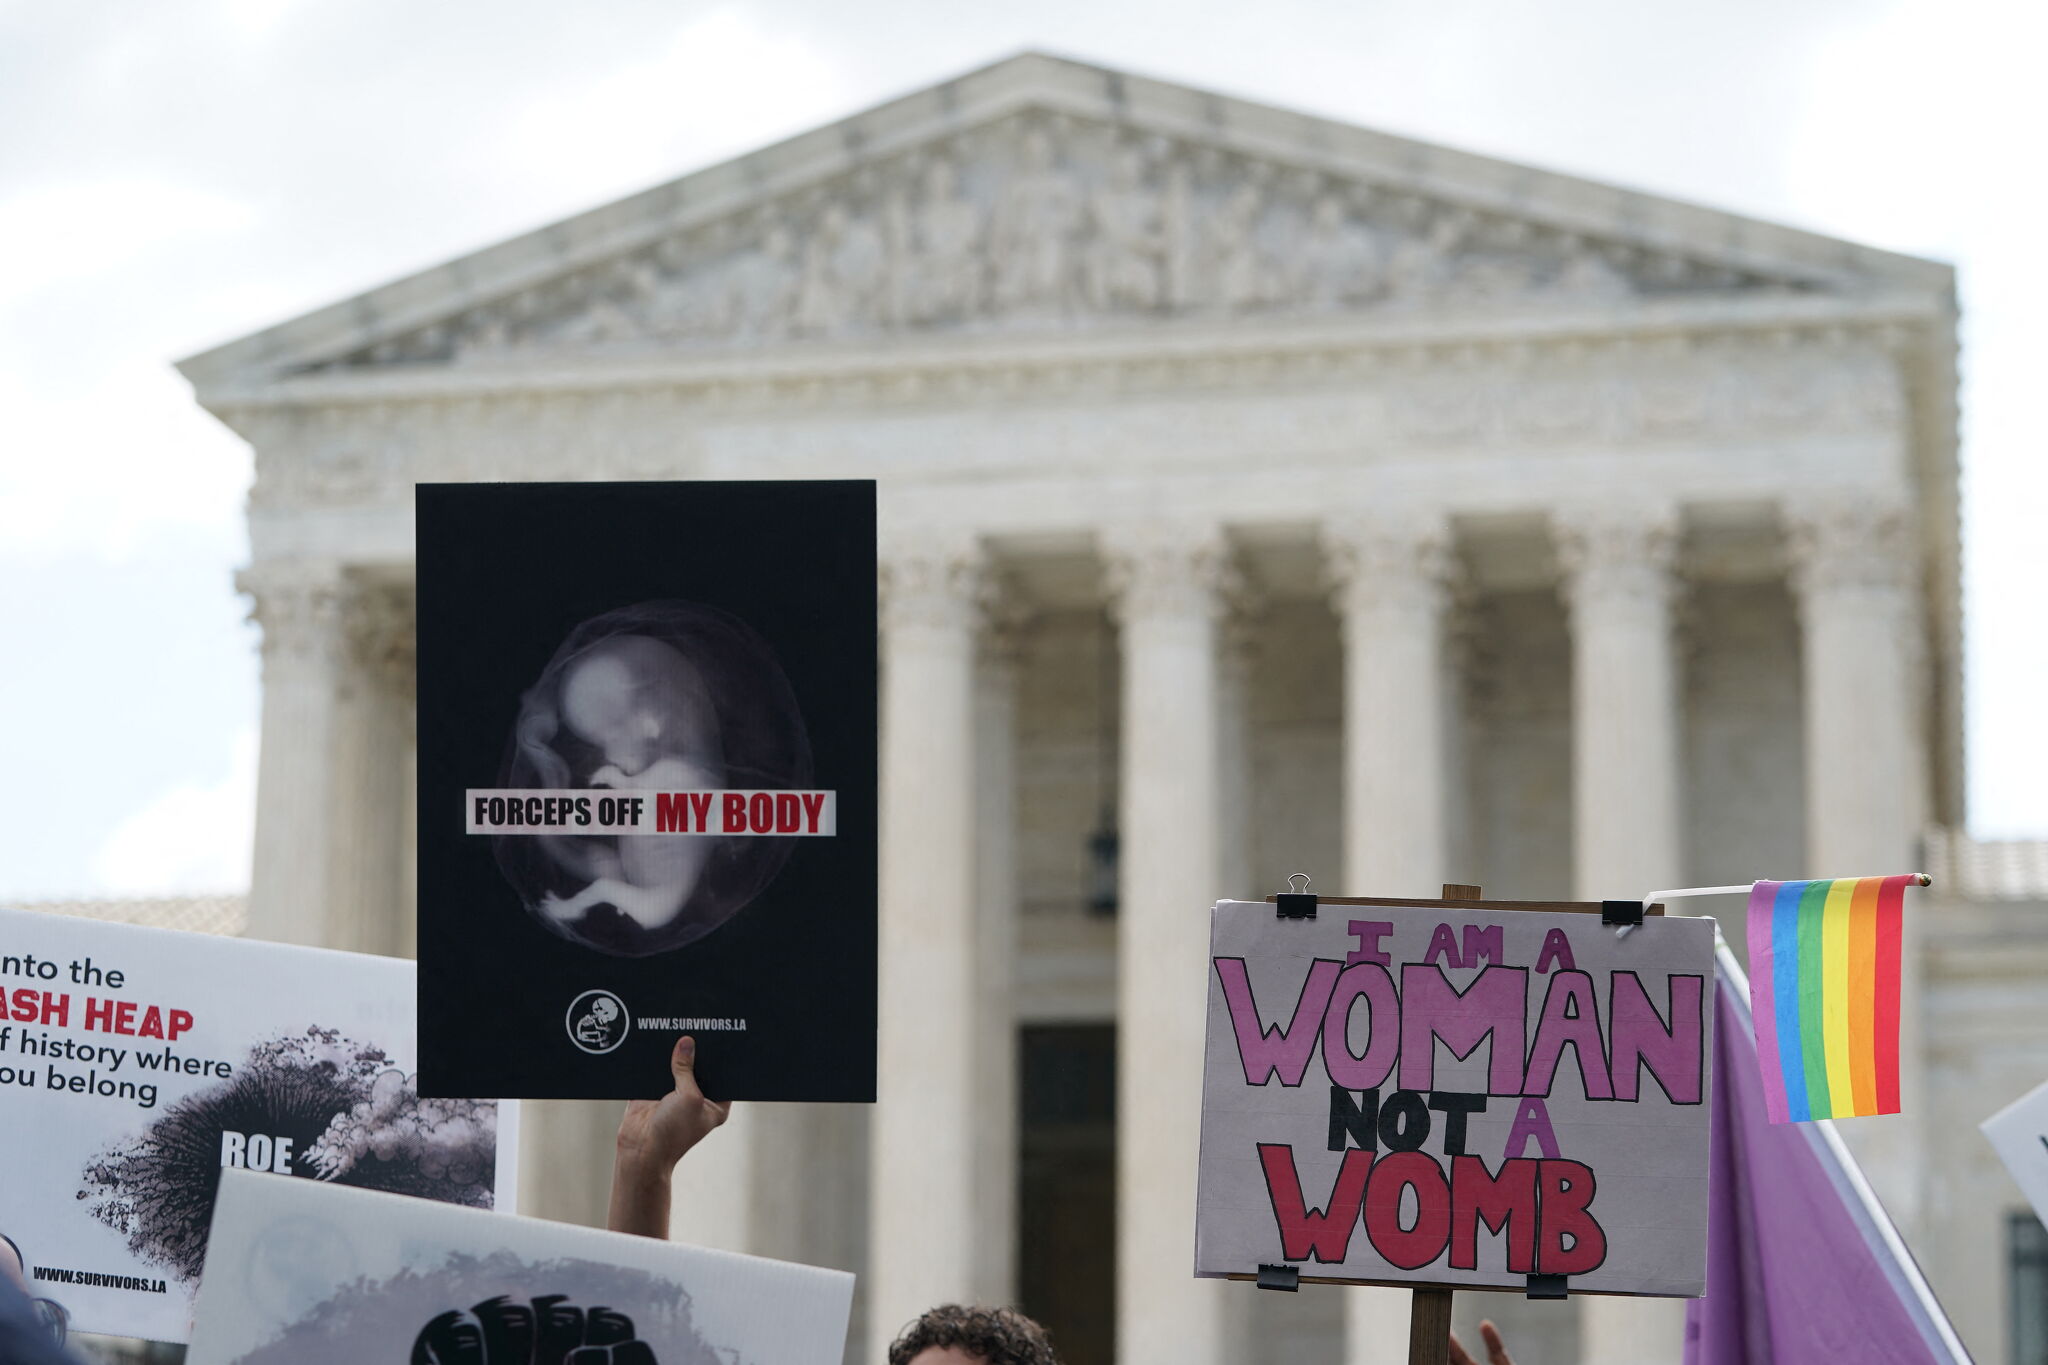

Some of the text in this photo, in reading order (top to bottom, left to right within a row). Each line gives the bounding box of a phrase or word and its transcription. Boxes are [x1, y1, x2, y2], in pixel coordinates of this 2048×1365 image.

[474, 792, 826, 834] FORCEPS OFF MY BODY
[1346, 920, 1577, 974] I AM A
[69, 957, 125, 988] the
[84, 997, 194, 1041] HEAP
[637, 1017, 747, 1031] WWW.SURVIVORS.LA
[1213, 955, 1704, 1105] WOMAN
[20, 1029, 127, 1072] history
[135, 1046, 232, 1079] where
[47, 1064, 157, 1108] belong
[1328, 1085, 1561, 1159] NOT A
[221, 1130, 294, 1175] ROE
[1256, 1142, 1607, 1275] WOMB
[33, 1266, 167, 1293] WWW.SURVIVORS.LA
